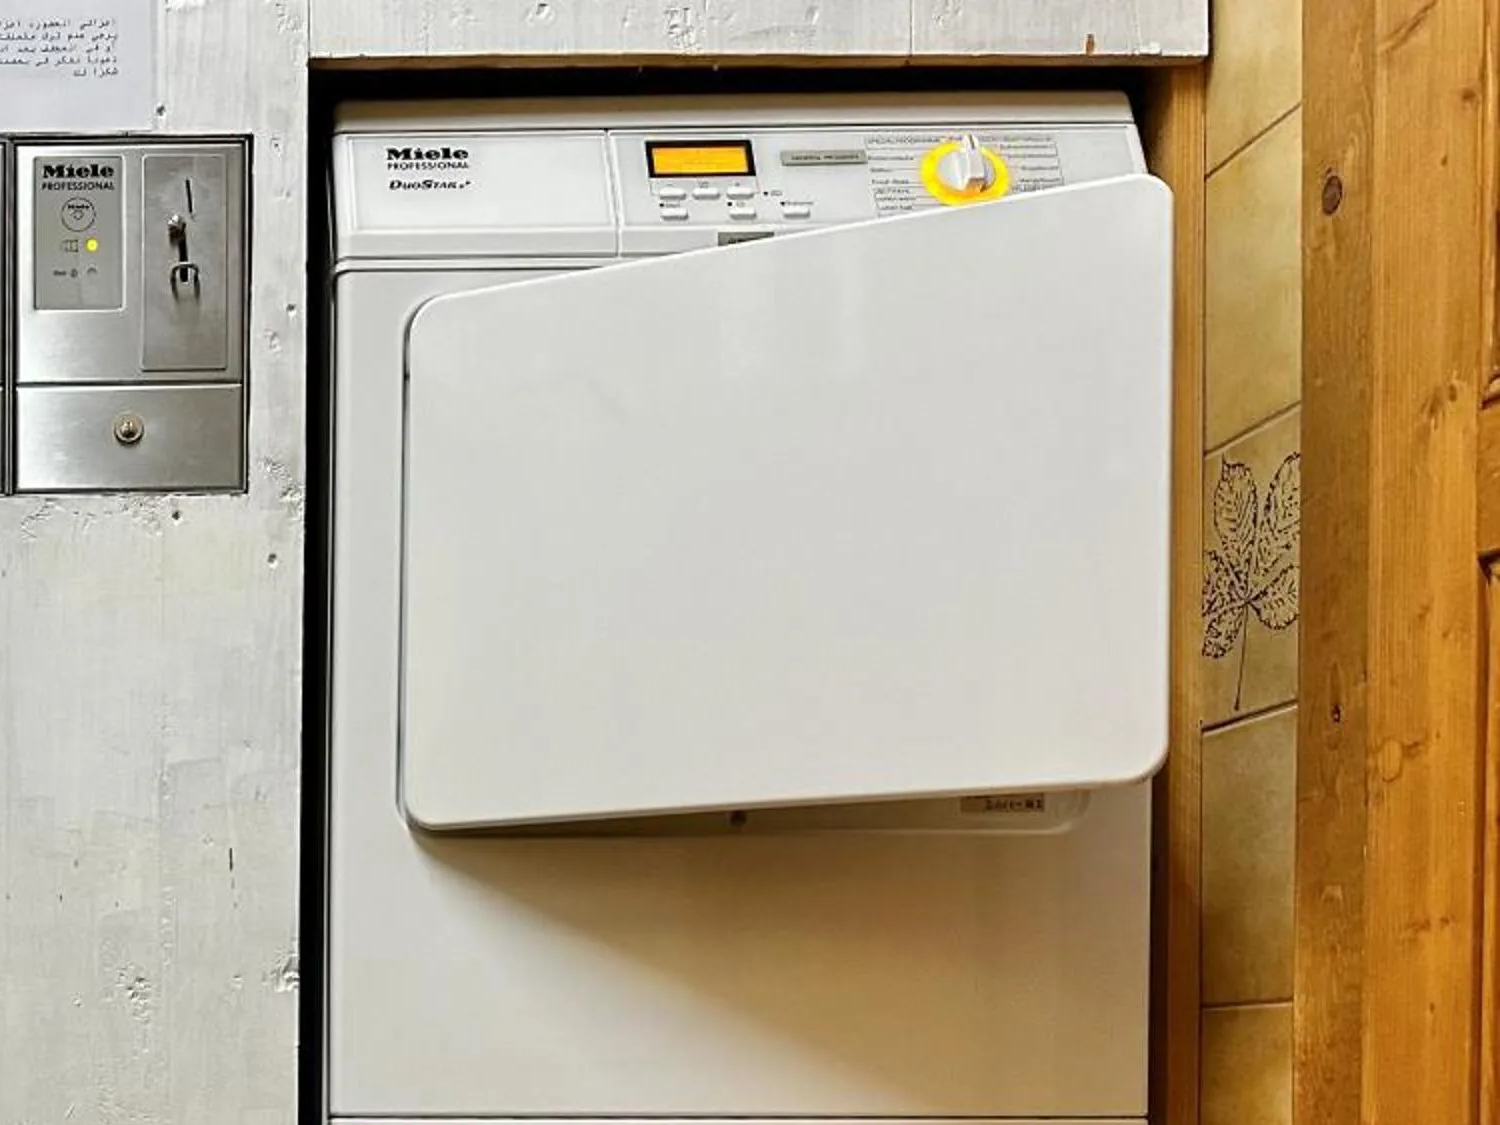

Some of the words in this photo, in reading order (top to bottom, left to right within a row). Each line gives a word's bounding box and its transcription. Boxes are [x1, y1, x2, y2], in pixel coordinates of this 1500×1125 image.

[386, 147, 469, 161] Miele
[43, 164, 114, 179] Miele
[387, 161, 469, 170] PROFESSIONAL
[41, 181, 115, 191] PROFESSIONAL
